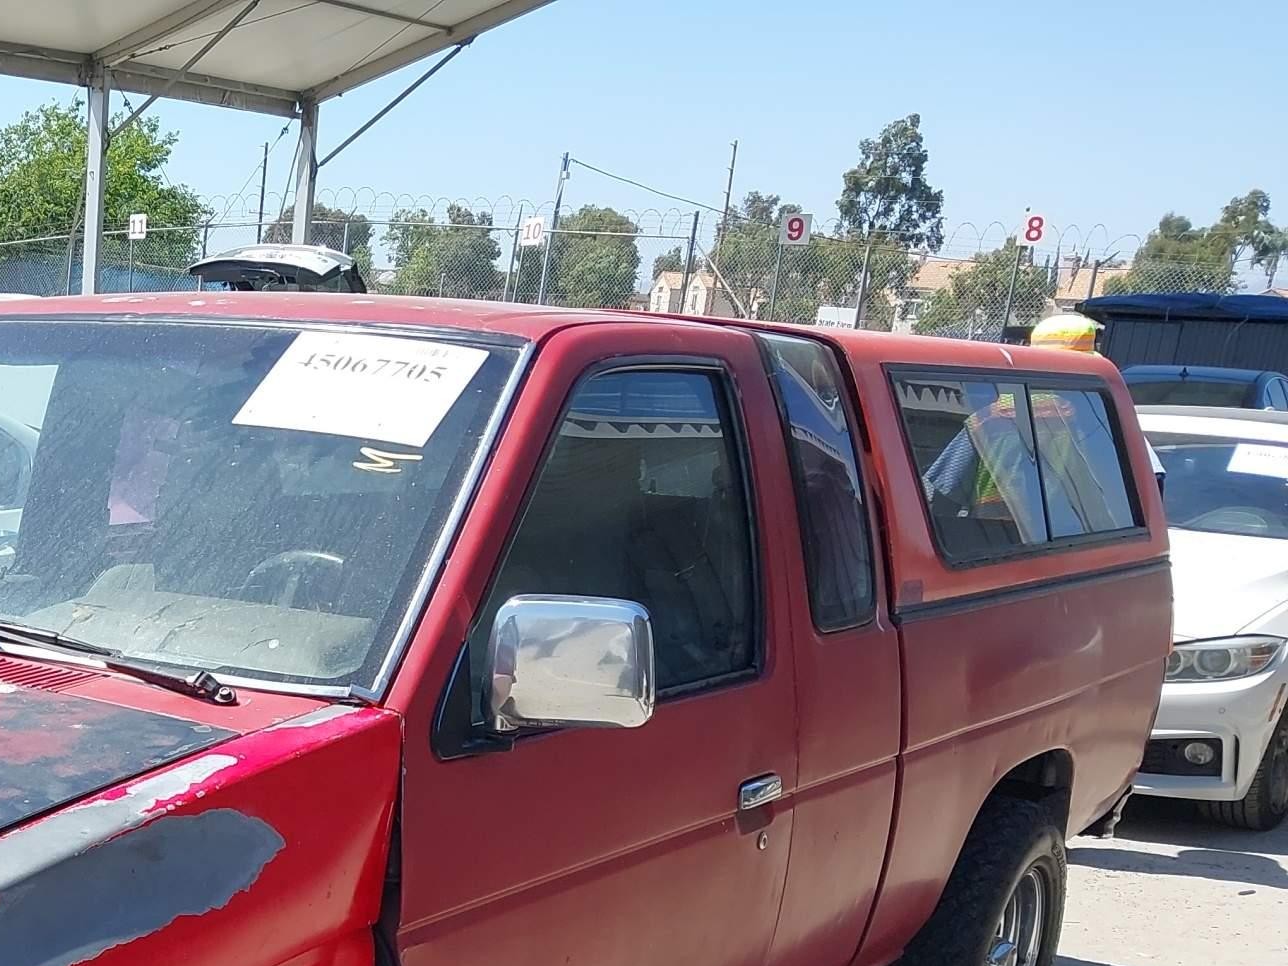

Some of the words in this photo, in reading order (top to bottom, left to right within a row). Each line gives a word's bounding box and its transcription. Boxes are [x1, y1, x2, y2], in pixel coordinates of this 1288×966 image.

[131, 219, 145, 234] 11
[523, 222, 542, 241] 10
[787, 217, 804, 241] 9
[1025, 216, 1044, 242] 8
[297, 352, 448, 383] 45067705
